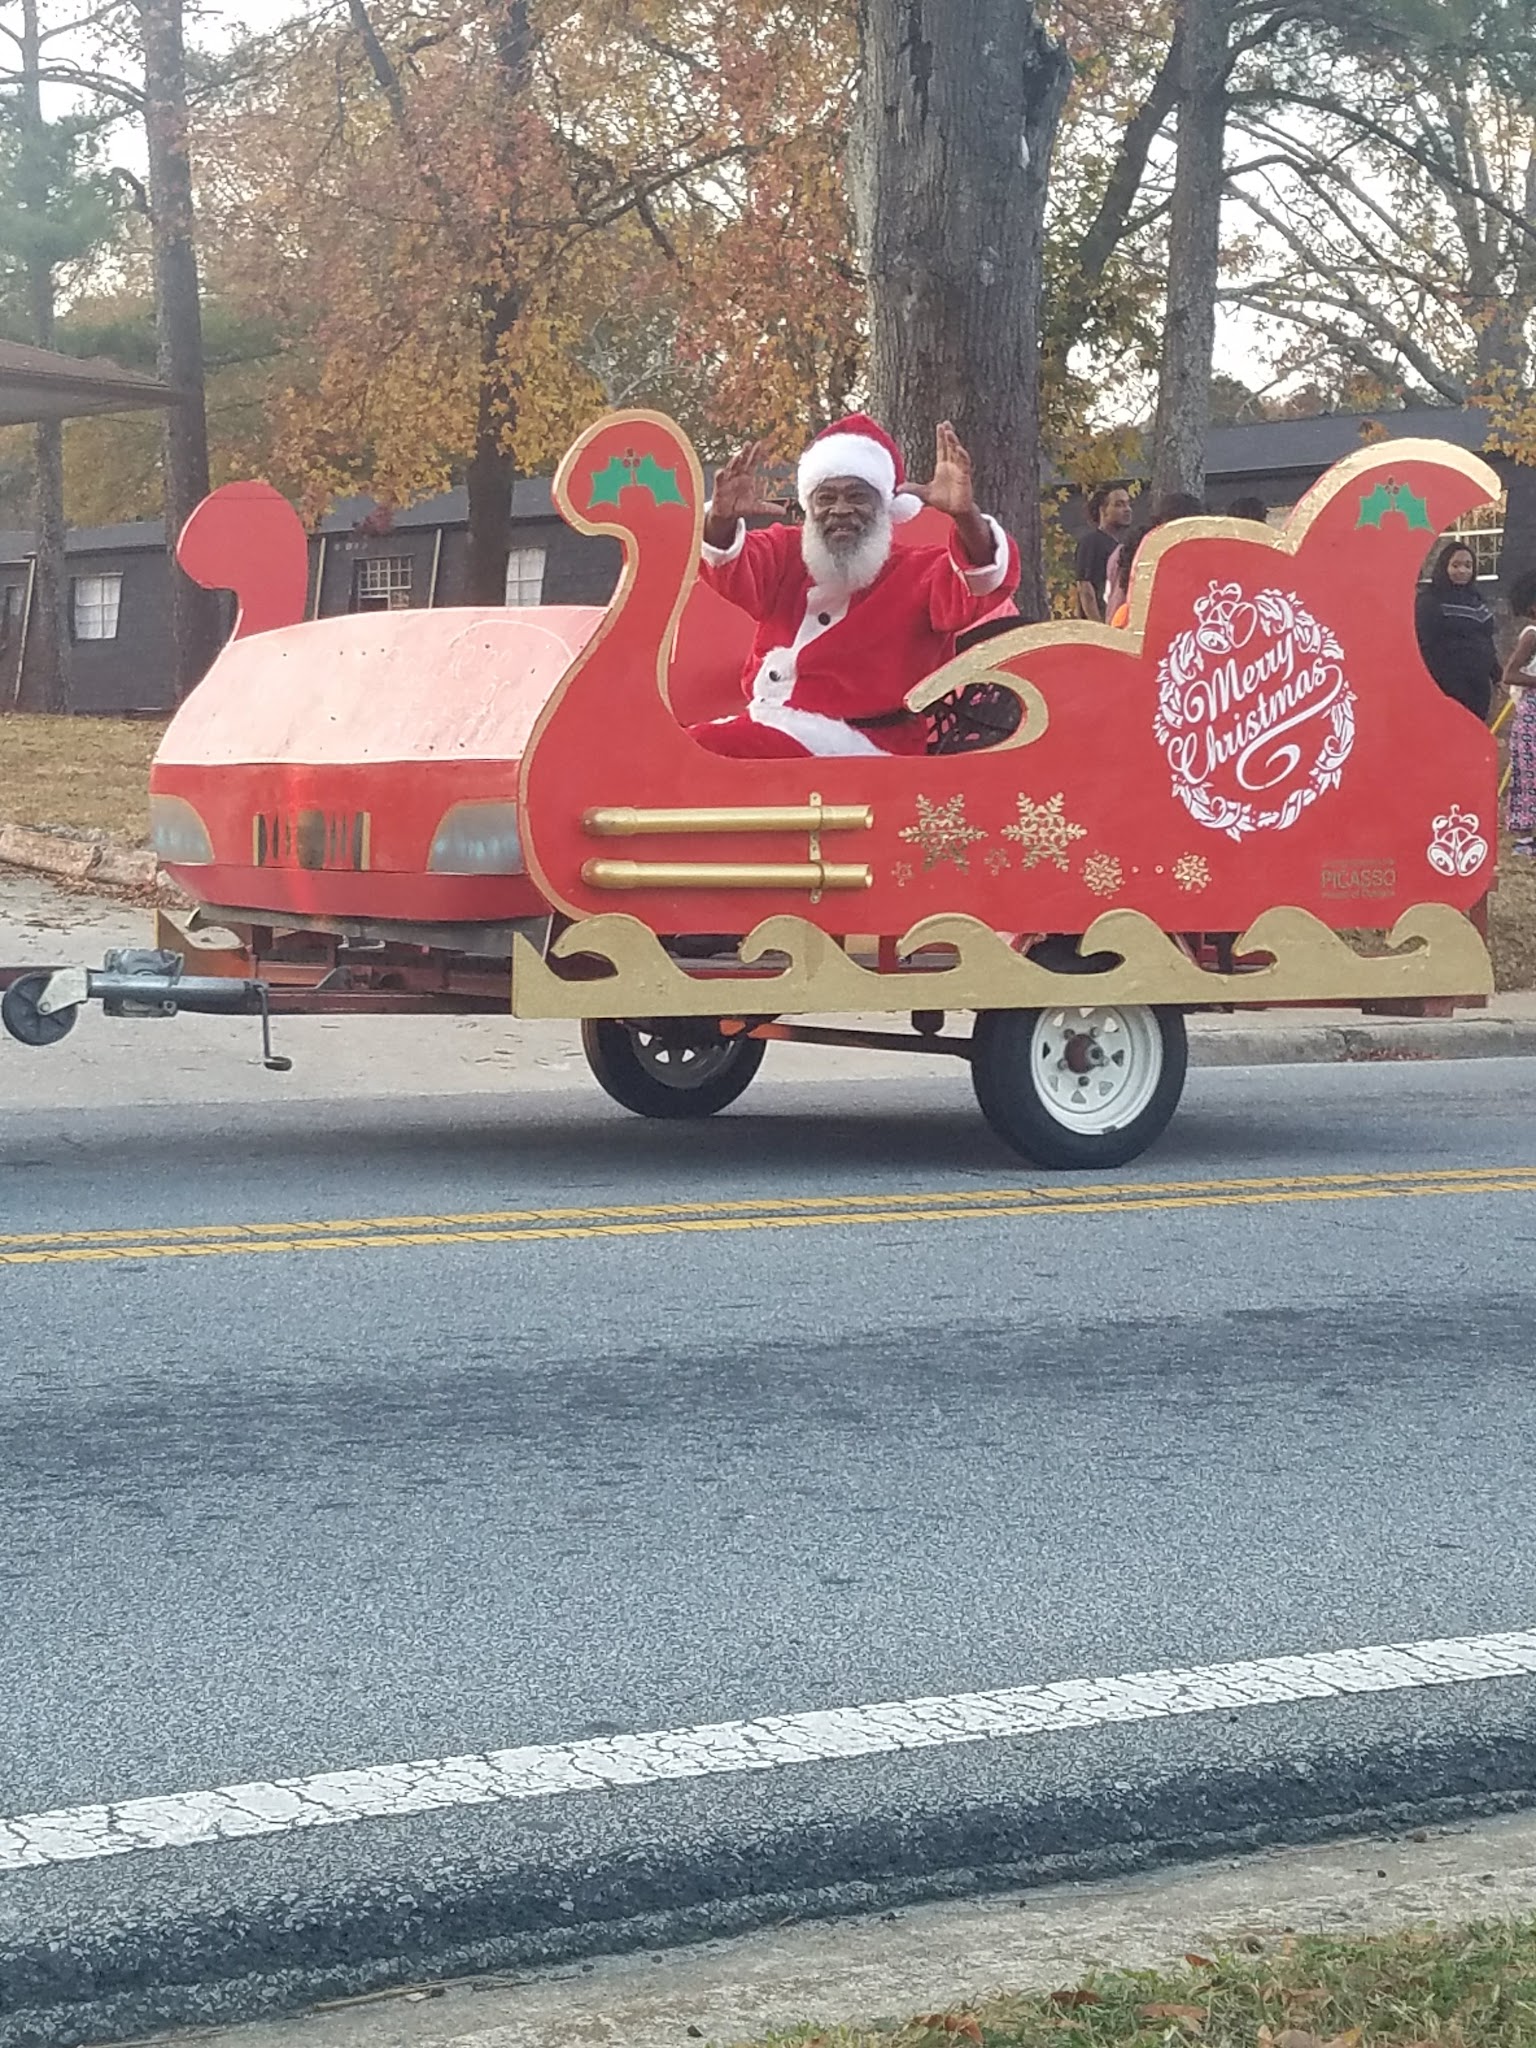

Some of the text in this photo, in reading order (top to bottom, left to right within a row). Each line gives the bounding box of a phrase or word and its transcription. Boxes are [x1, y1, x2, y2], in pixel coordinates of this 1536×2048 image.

[1183, 632, 1295, 723] Merry
[1167, 657, 1343, 791] Christmas
[1321, 869, 1397, 889] PICASSO
